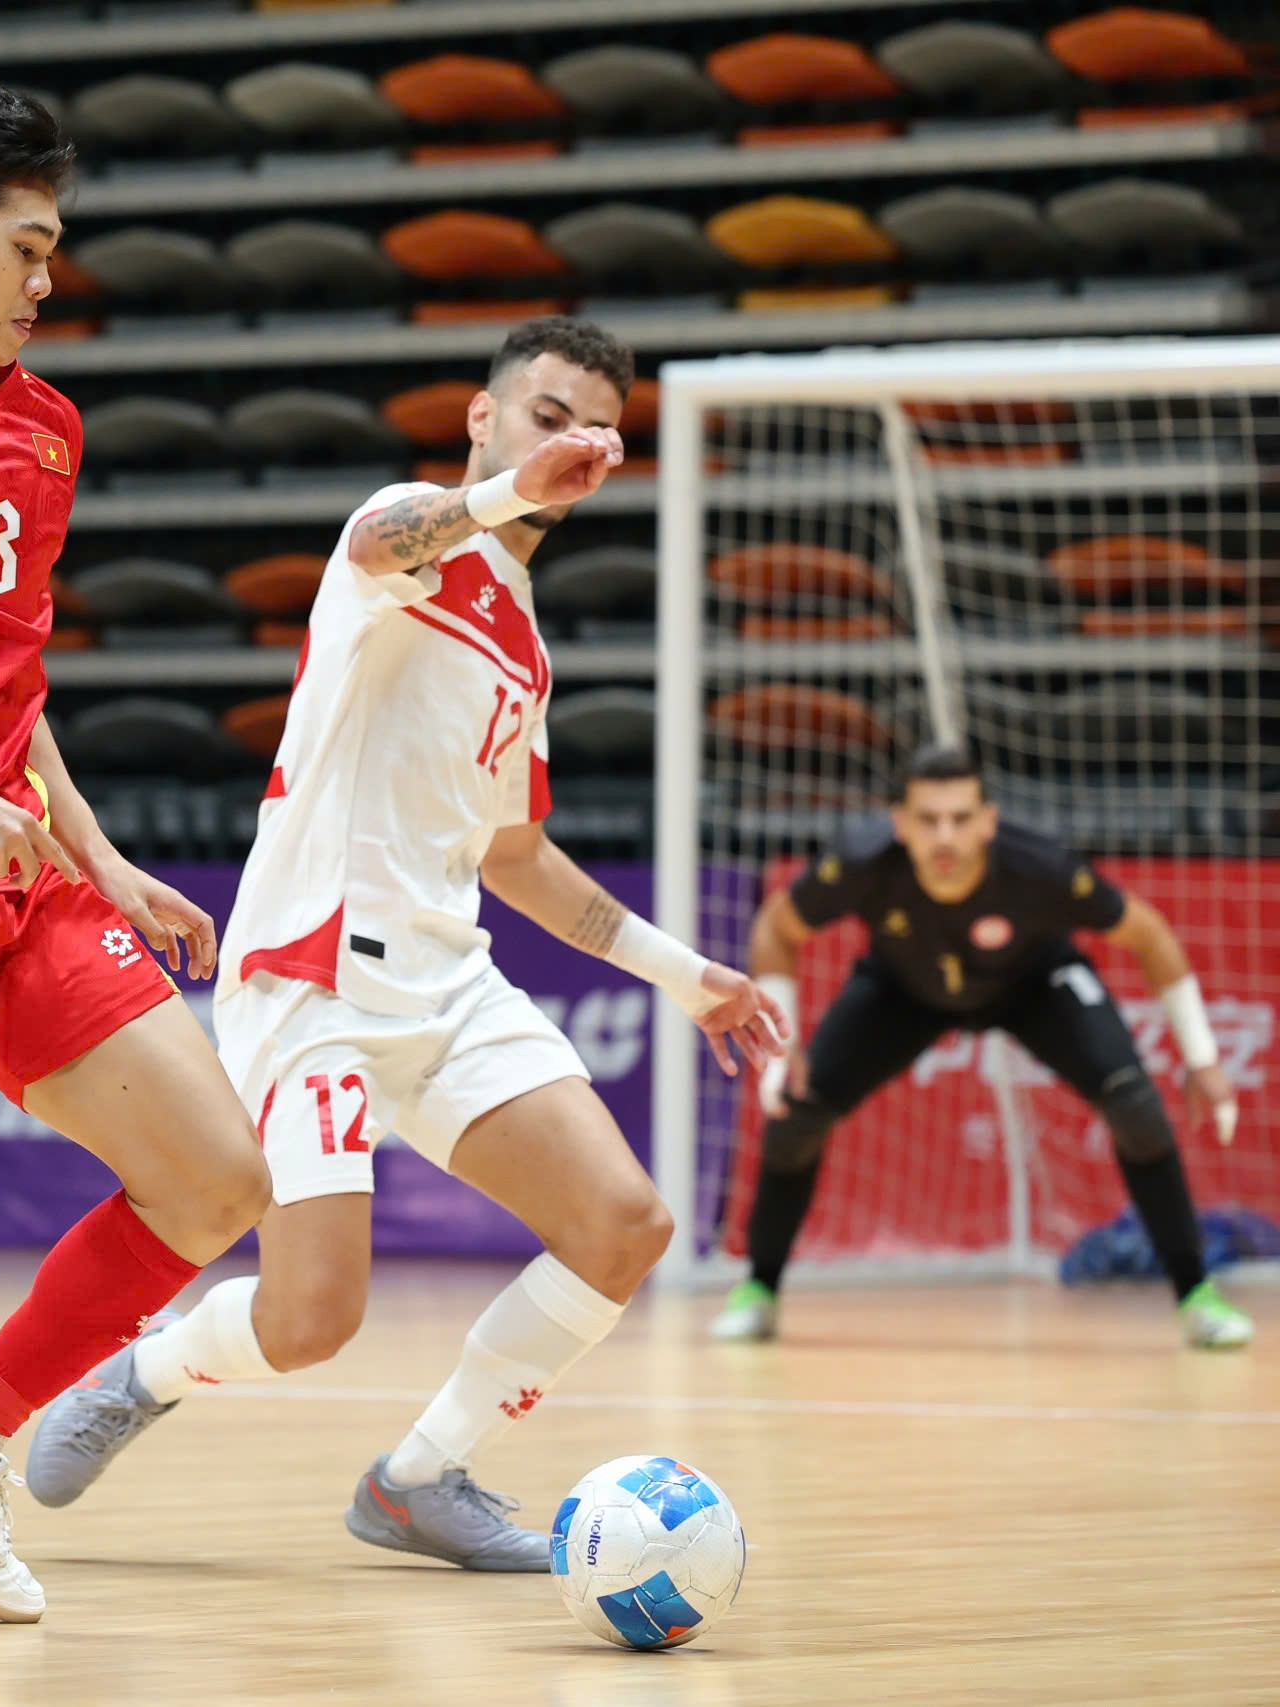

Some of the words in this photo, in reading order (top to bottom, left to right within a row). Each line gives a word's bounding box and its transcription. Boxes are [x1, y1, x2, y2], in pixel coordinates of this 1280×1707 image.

[476, 683, 522, 779] 12
[940, 953, 963, 995] 1
[305, 1074, 369, 1154] 12
[587, 1509, 605, 1566] molten
